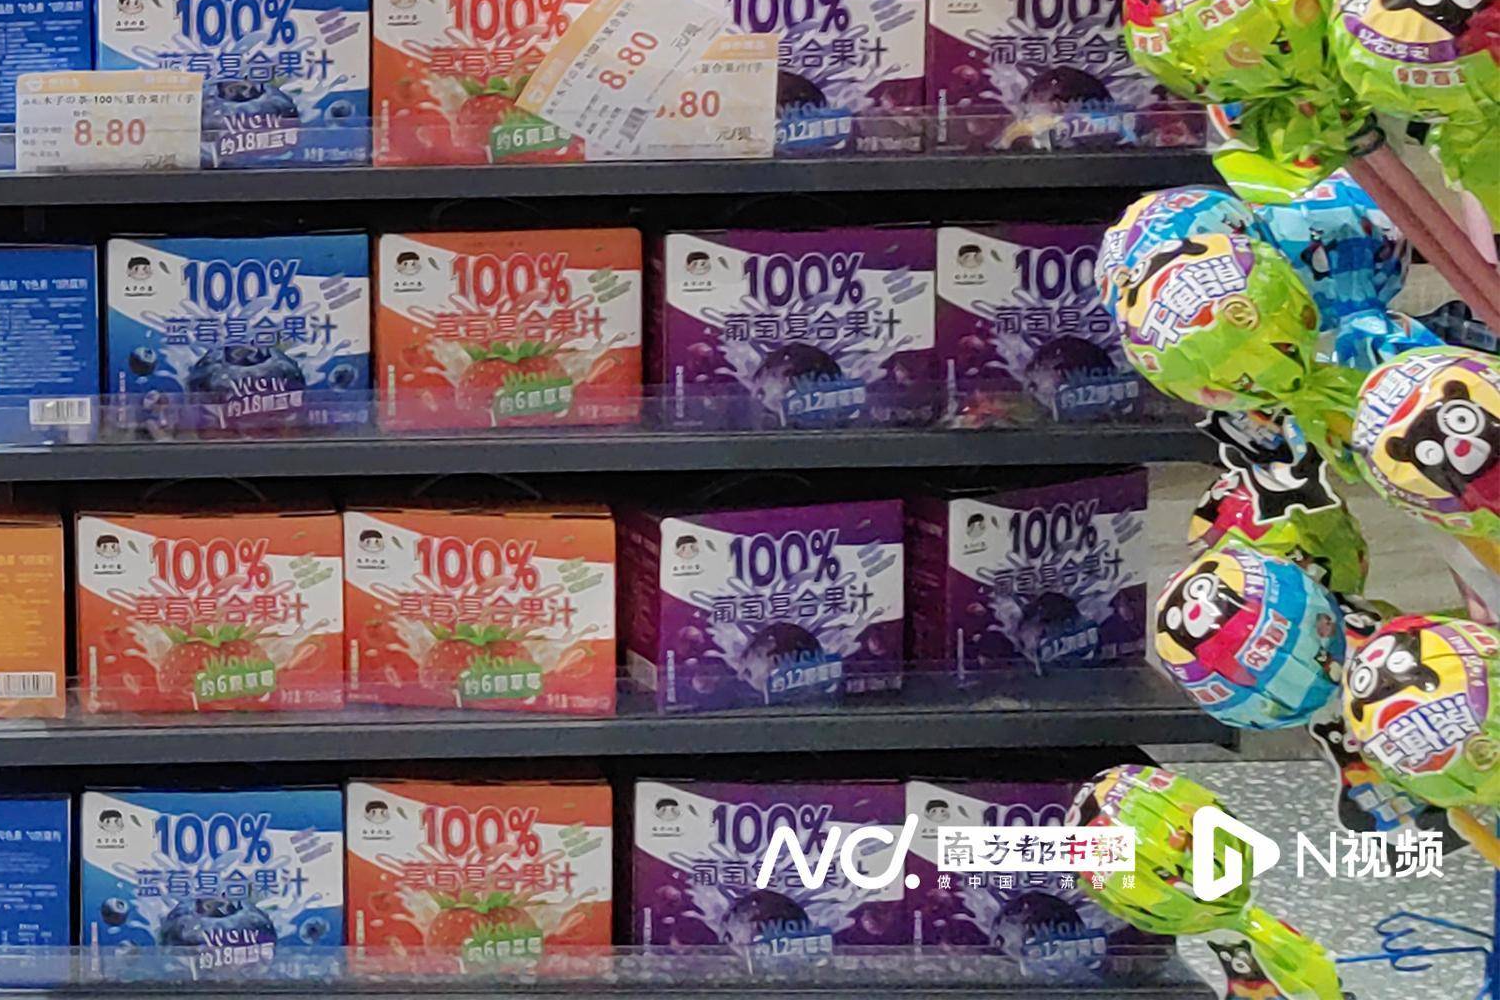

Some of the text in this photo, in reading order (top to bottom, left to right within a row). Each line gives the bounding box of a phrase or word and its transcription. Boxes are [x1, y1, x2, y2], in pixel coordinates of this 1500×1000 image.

[599, 30, 661, 92] 8.80
[656, 88, 722, 120] .80
[73, 117, 147, 148] 8.80
[181, 257, 302, 313] 100%
[449, 250, 571, 306] 100%
[741, 251, 864, 308] 100%
[164, 315, 338, 348] 蓝莓复合果汁
[721, 308, 902, 342] 葡萄复合果汁
[1008, 500, 1100, 560] 100%
[150, 536, 273, 592] 100%
[414, 534, 538, 593] 100%
[729, 529, 840, 588] 100%
[711, 582, 875, 622] 葡萄复合果汁
[153, 811, 272, 865] 100%
[419, 804, 540, 861] 100%
[135, 867, 310, 899] 蓝莓复合果汁
